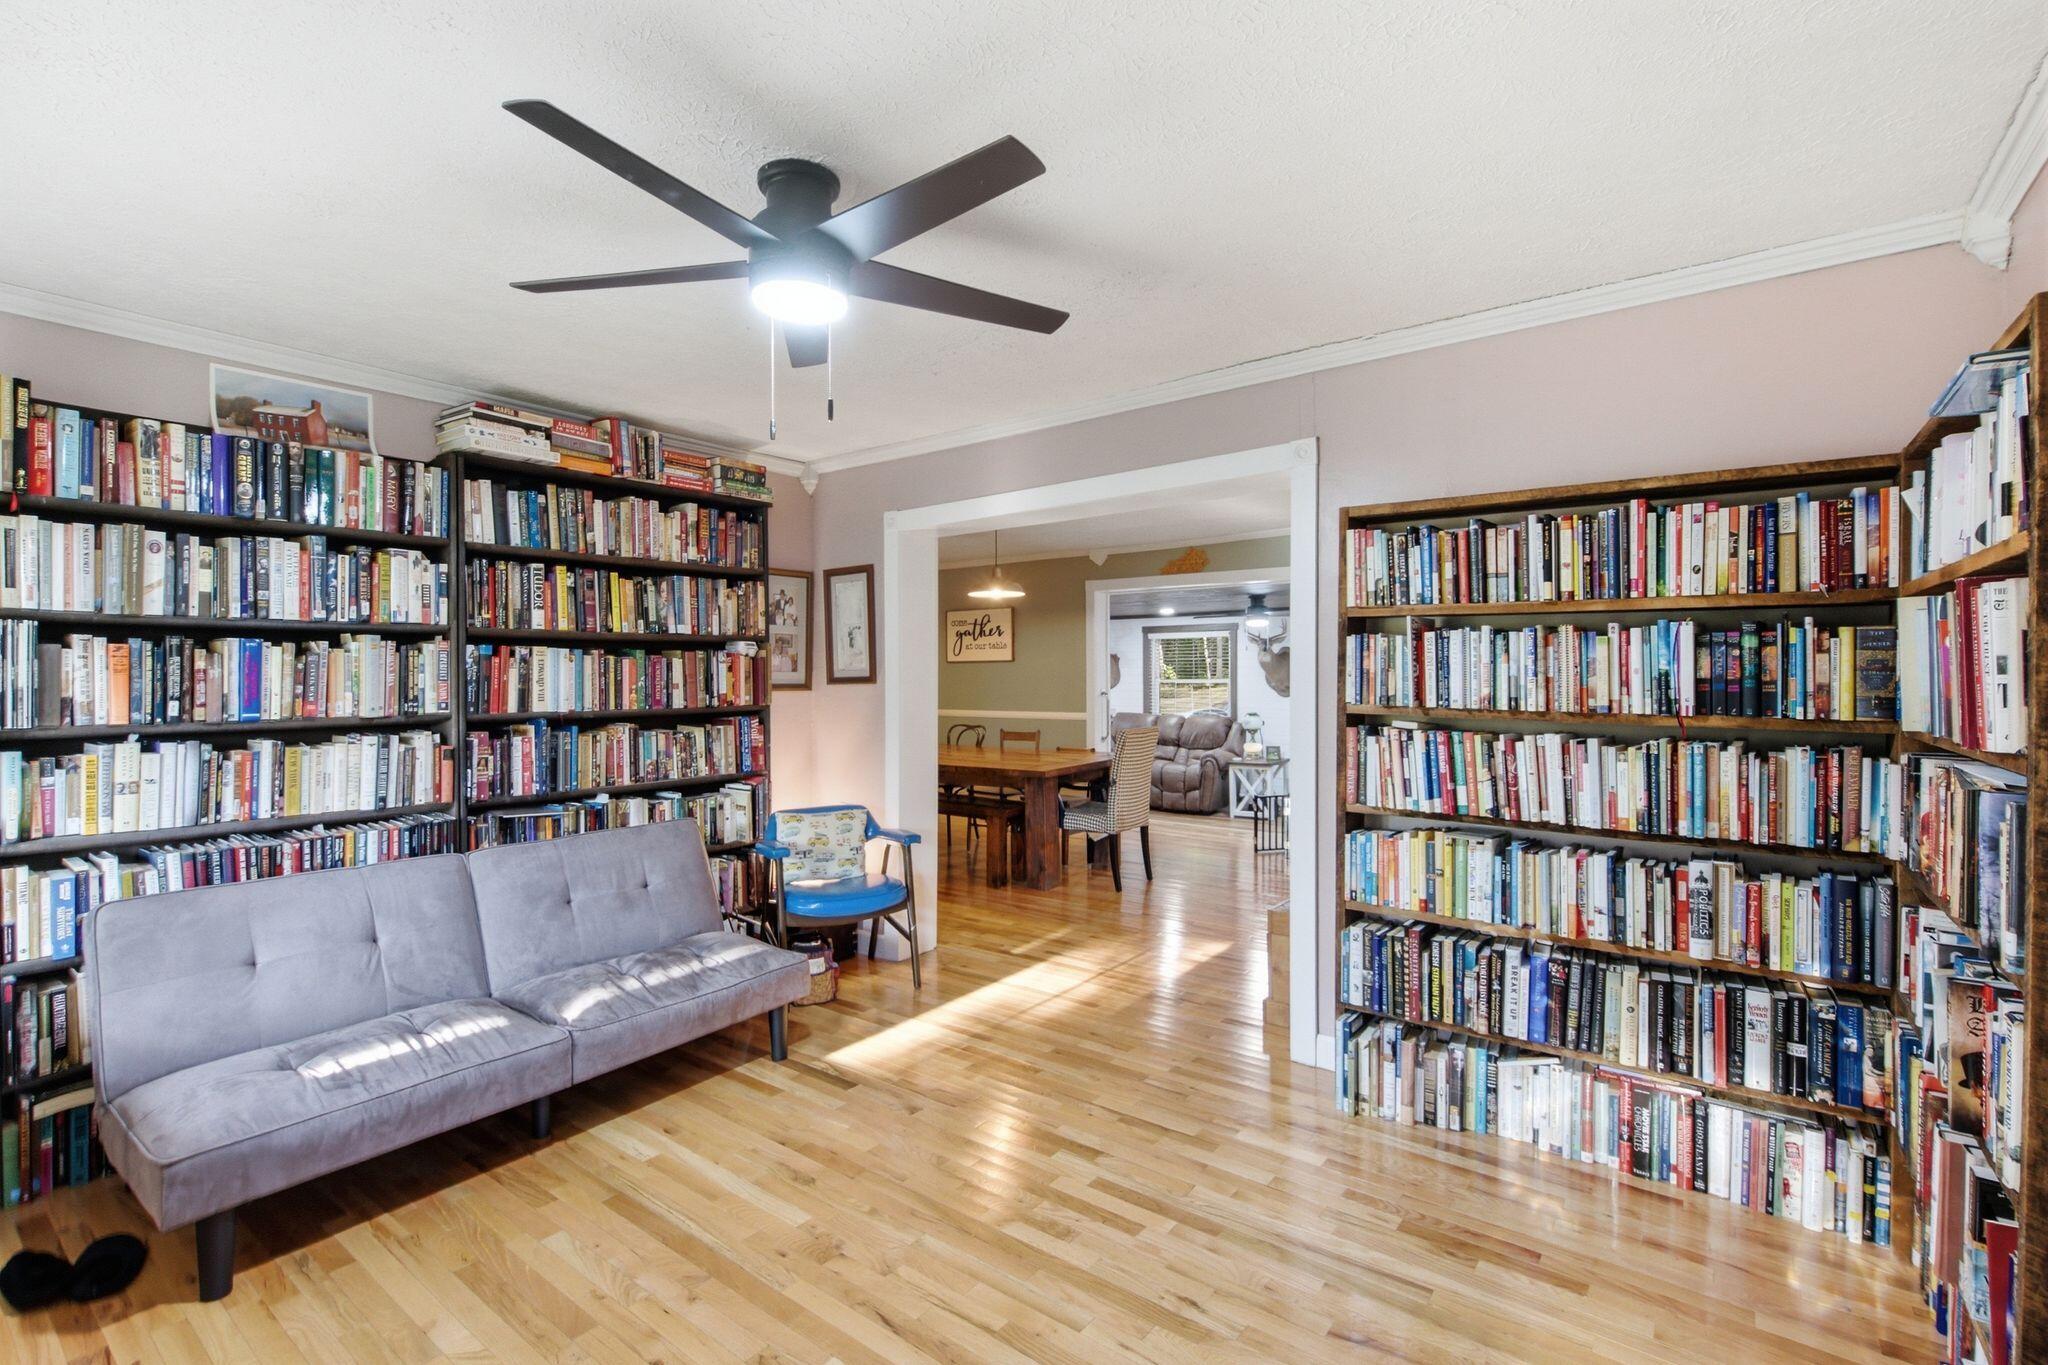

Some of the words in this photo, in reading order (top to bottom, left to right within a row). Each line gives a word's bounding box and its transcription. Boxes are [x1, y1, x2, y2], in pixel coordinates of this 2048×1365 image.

[387, 480, 398, 512] MARY
[1844, 517, 1852, 544] ISRAEL
[533, 569, 544, 609] TUDOR
[953, 614, 1004, 656] gather
[535, 659, 545, 687] EDWARD
[537, 688, 545, 702] VIII
[289, 750, 298, 766] NEW
[289, 768, 298, 789] YORK
[56, 906, 66, 941] SURVIVORS
[65, 907, 74, 922] The
[1699, 892, 1710, 936] POLITICS
[65, 922, 74, 937] Last
[1411, 943, 1419, 989] CEMETERIES
[1432, 941, 1440, 967] KORESH
[1432, 966, 1440, 994] STEPHAN
[1479, 958, 1488, 985] WORLD
[1509, 964, 1519, 994] BREAK
[1431, 994, 1440, 1015] TALTY
[1478, 985, 1488, 1015] HISTORY
[1509, 997, 1518, 1005] IT
[1509, 1008, 1518, 1020] UP
[1774, 1001, 1786, 1033] Rosemary
[1735, 1020, 1744, 1053] CAMELOT
[1823, 1041, 1832, 1078] CAMELOT
[1633, 1106, 1643, 1152] CHRONICLES
[1641, 1107, 1650, 1132] MOVIE
[1641, 1133, 1651, 1153] STAR
[1696, 1119, 1705, 1174] GHOSTLAND
